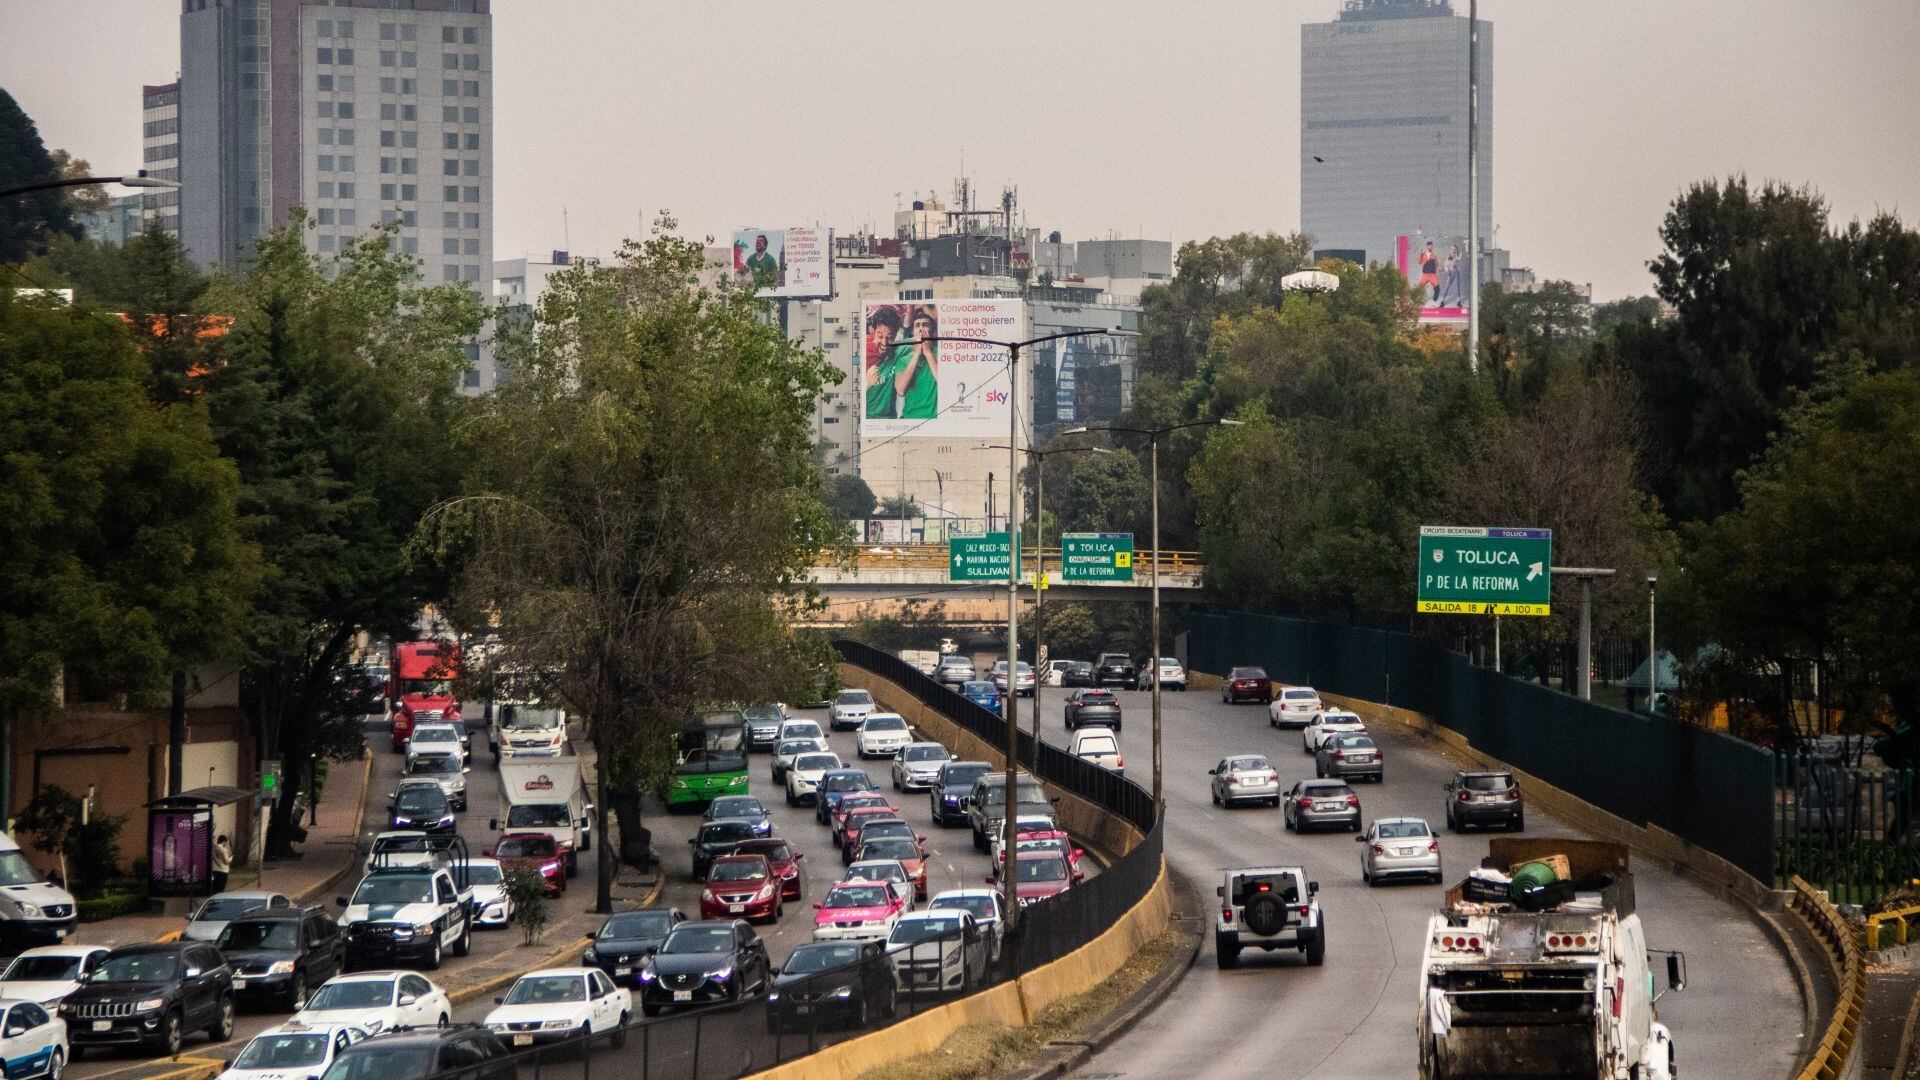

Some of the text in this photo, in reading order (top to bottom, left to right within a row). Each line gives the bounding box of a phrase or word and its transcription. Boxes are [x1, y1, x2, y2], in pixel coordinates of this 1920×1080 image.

[940, 304, 996, 312] Convocamos
[948, 316, 960, 324] los
[963, 318, 979, 326] que
[982, 316, 1015, 326] quieren
[957, 328, 988, 337] TODOS
[940, 341, 992, 351] los partidos
[941, 353, 952, 362] de
[954, 353, 978, 363] Qatar
[986, 390, 1008, 405] sky
[966, 544, 977, 552] CALZ
[1456, 550, 1520, 565] TOLUCA
[967, 568, 1010, 576] SULLIVAN
[1089, 567, 1115, 576] REFORMA
[1426, 575, 1519, 590] P DE LA REFORMA
[1425, 603, 1461, 612] SALIDA
[1468, 604, 1477, 612] 18
[1516, 606, 1530, 614] 100
